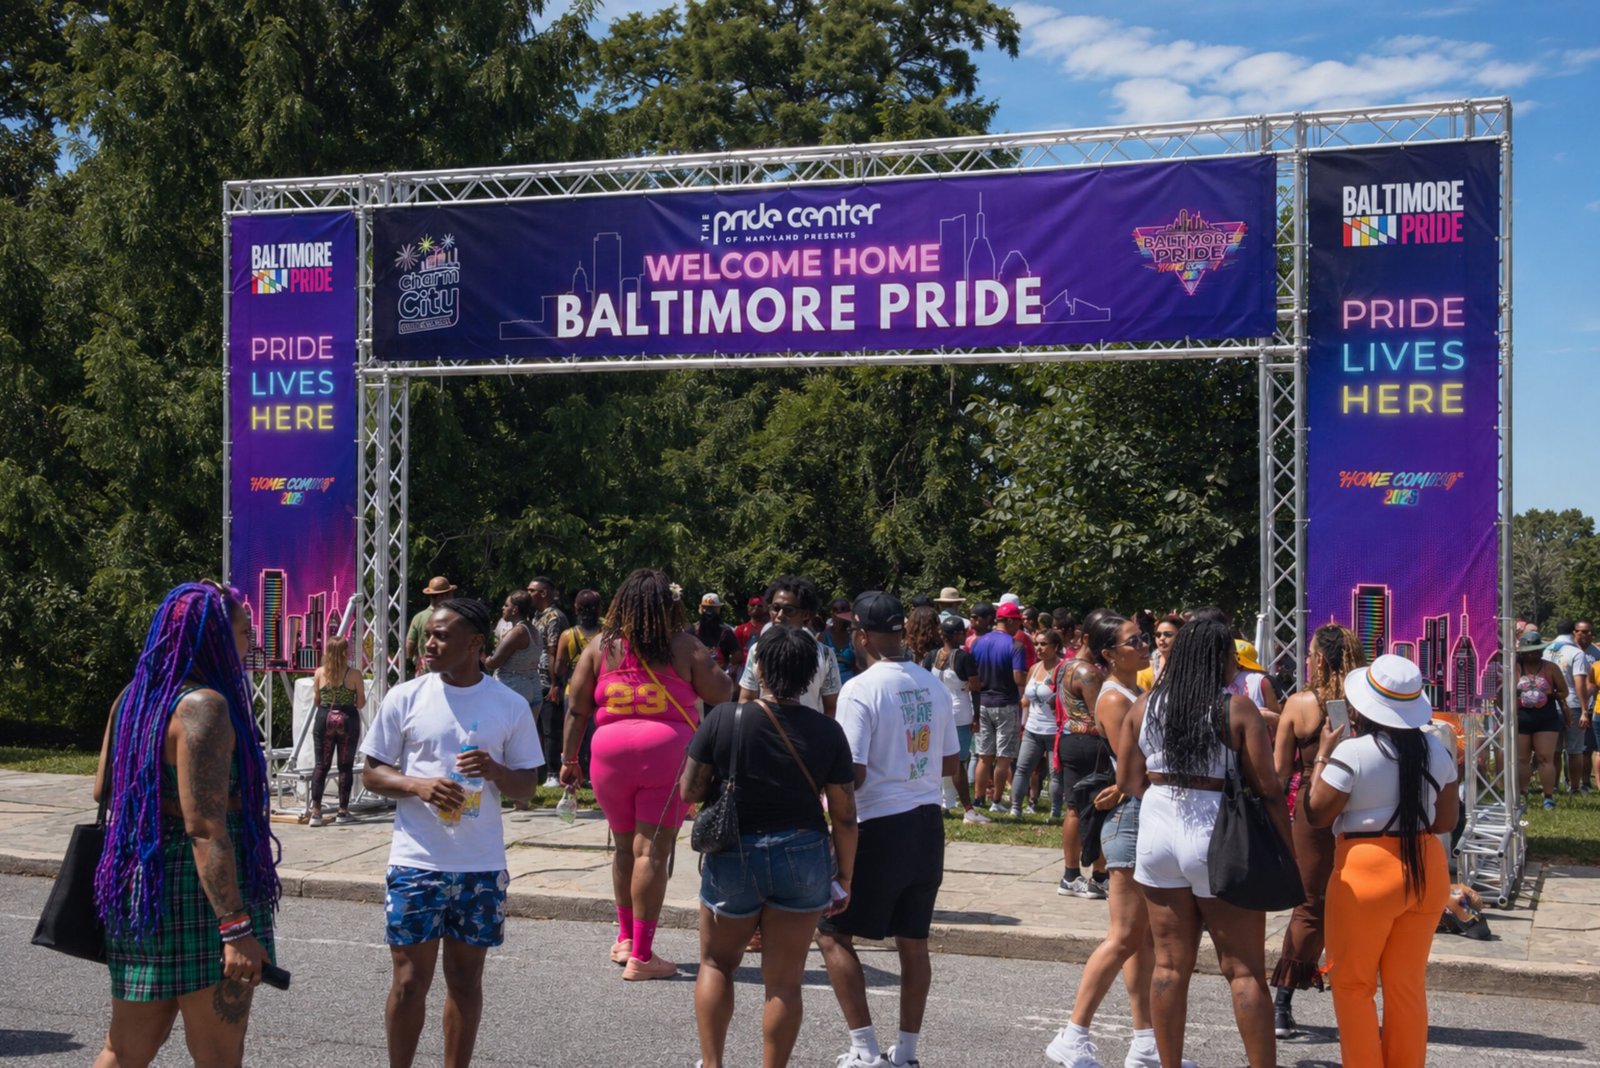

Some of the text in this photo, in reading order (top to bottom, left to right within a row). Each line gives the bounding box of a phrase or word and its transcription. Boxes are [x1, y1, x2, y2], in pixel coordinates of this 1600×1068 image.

[1343, 180, 1464, 216] BALTIMORE
[700, 214, 710, 241] THE
[713, 198, 881, 245] pride center
[745, 234, 799, 242] MARYLAND
[804, 232, 856, 240] PRESENTS
[1401, 212, 1464, 245] PRIDE
[252, 242, 333, 269] BALTIMORE
[645, 244, 940, 282] WELCOME HOME
[1154, 246, 1225, 263] PRIDE
[290, 267, 333, 293] PRIDE
[557, 277, 1041, 338] BALTIMORE PRIDE
[1343, 297, 1465, 329] PRIDE
[252, 336, 333, 361] PRIDE
[1343, 340, 1465, 372] LIVES
[252, 370, 333, 395] LIVES
[1343, 383, 1464, 414] HERE
[252, 405, 333, 430] HERE
[605, 683, 667, 714] 23
